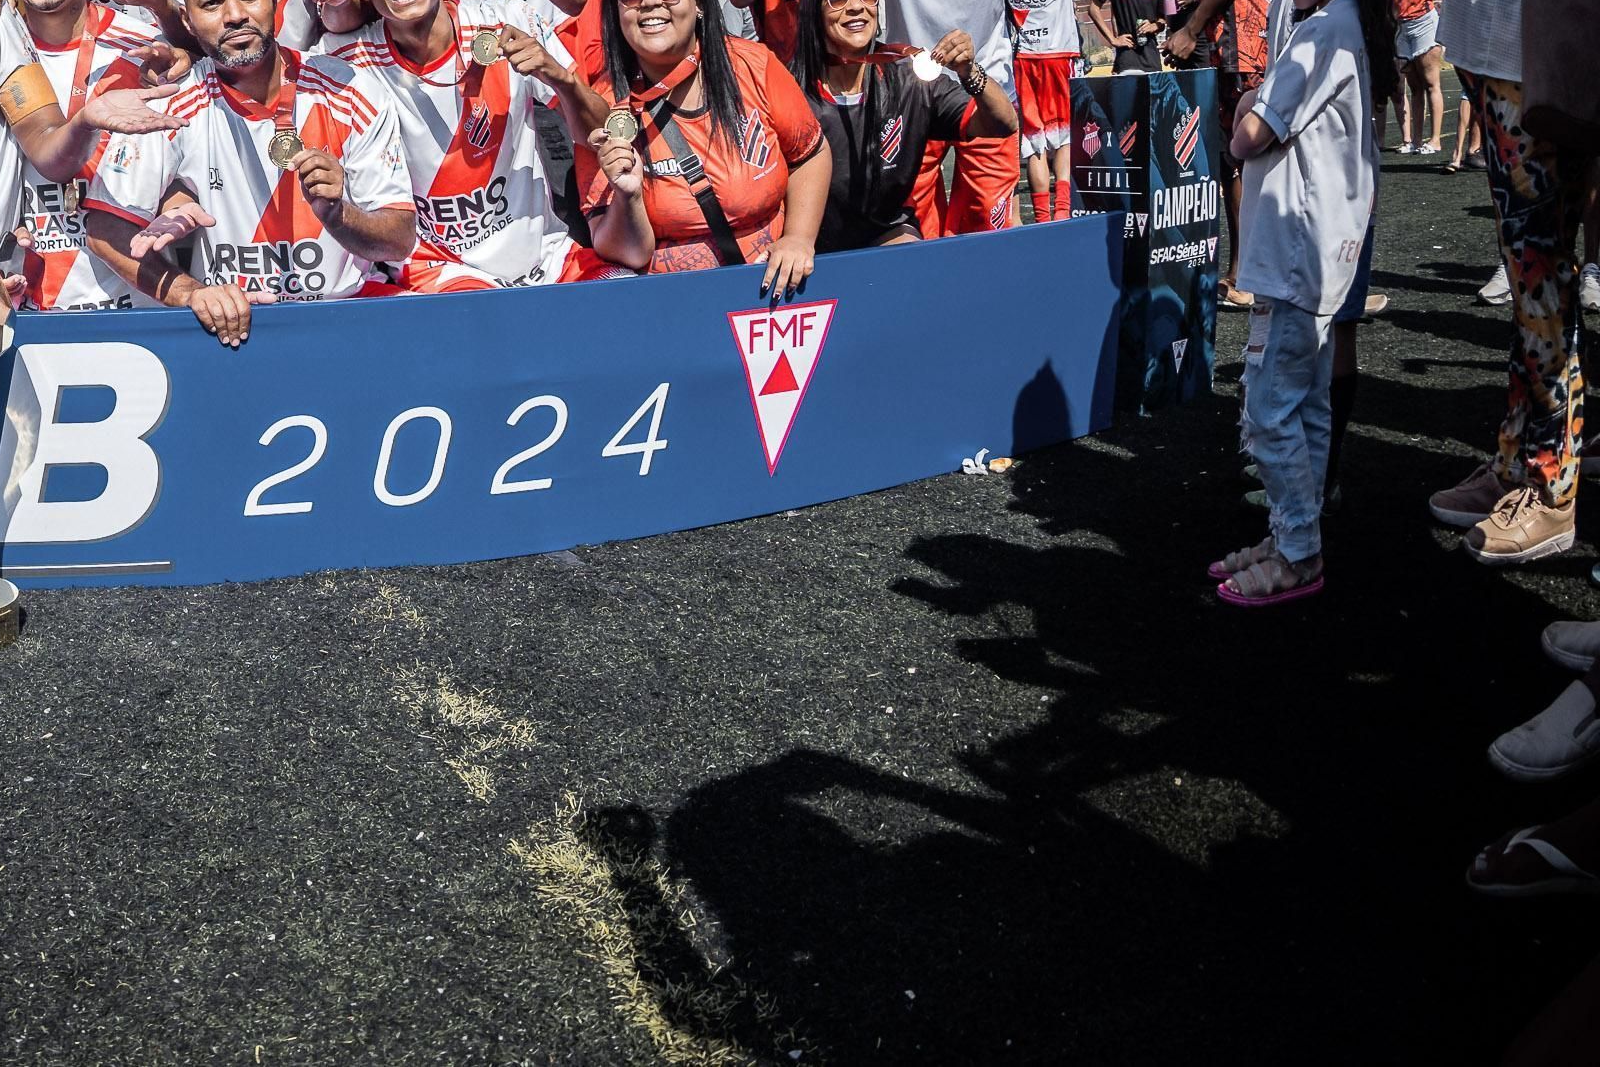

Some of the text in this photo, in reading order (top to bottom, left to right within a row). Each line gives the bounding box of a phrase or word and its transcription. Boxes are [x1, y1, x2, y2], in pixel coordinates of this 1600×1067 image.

[413, 175, 507, 223] RENO
[1087, 172, 1131, 189] FINAL
[1153, 174, 1217, 230] CAMPEÃO
[417, 195, 510, 242] OLASCO
[208, 240, 324, 275] RENO
[1150, 239, 1207, 265] SFAC Série B
[1187, 256, 1206, 268] 2024
[747, 311, 818, 356] FMF
[243, 381, 671, 517] 2024
